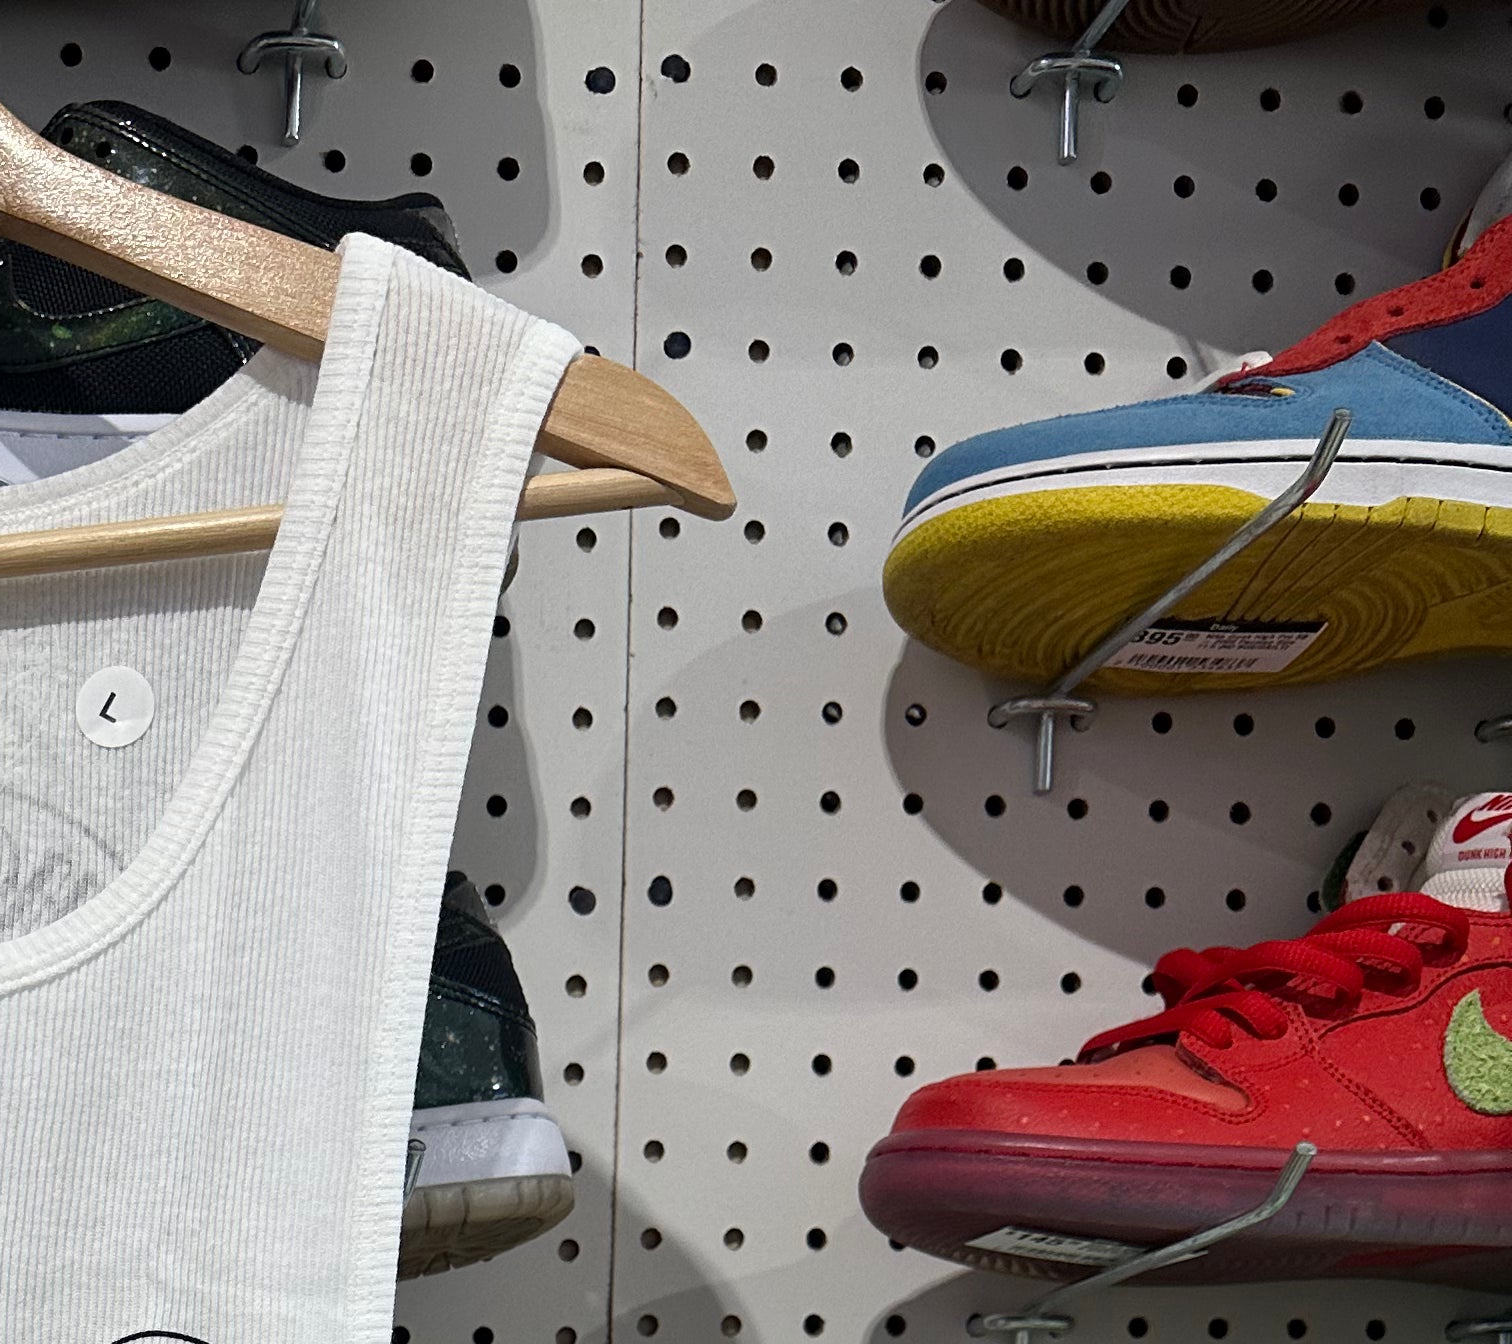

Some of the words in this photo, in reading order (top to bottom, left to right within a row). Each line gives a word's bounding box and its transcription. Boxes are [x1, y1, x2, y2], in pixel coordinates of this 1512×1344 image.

[98, 691, 117, 724] L
[1457, 848, 1482, 862] DUNK
[1483, 846, 1507, 860] HIGH
